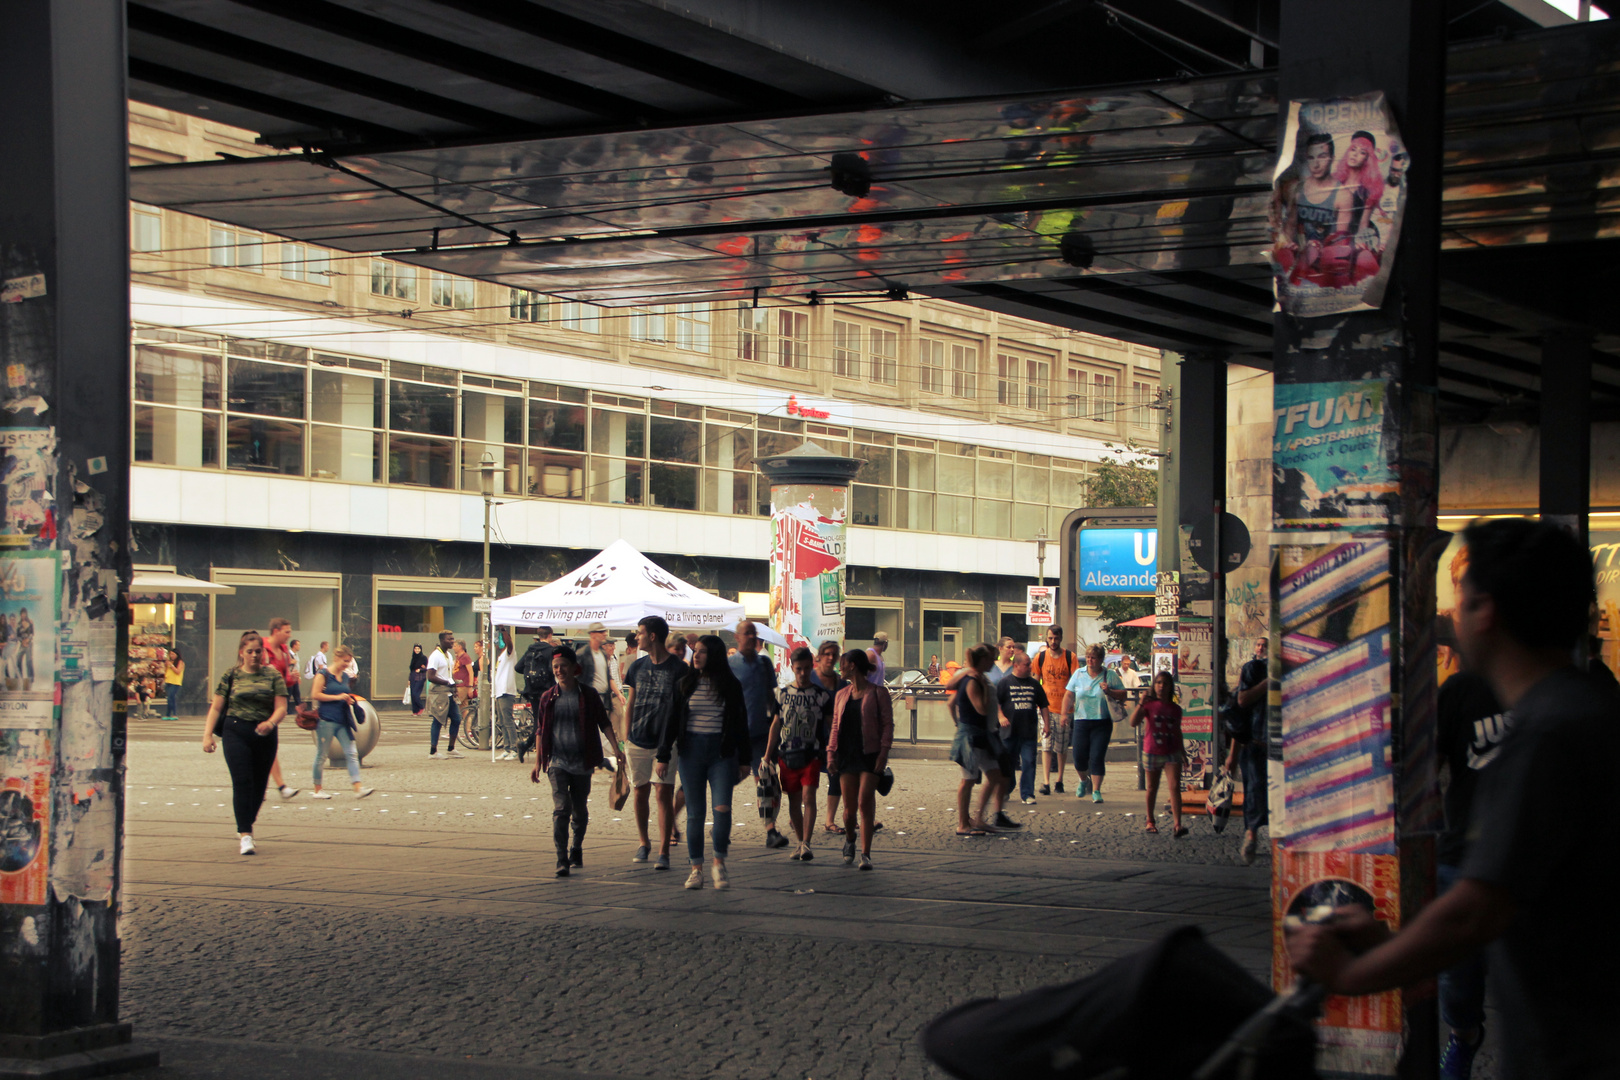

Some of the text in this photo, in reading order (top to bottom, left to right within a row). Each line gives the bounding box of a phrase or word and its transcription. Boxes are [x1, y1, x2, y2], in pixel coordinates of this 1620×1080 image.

[1281, 451, 1322, 465] Indoor
[1134, 532, 1157, 566] U
[1292, 541, 1366, 593] SINGULARITY
[521, 609, 608, 622] for a living planet
[665, 610, 724, 625] for a living planet
[817, 628, 835, 636] WITH
[784, 694, 818, 707] BRONX
